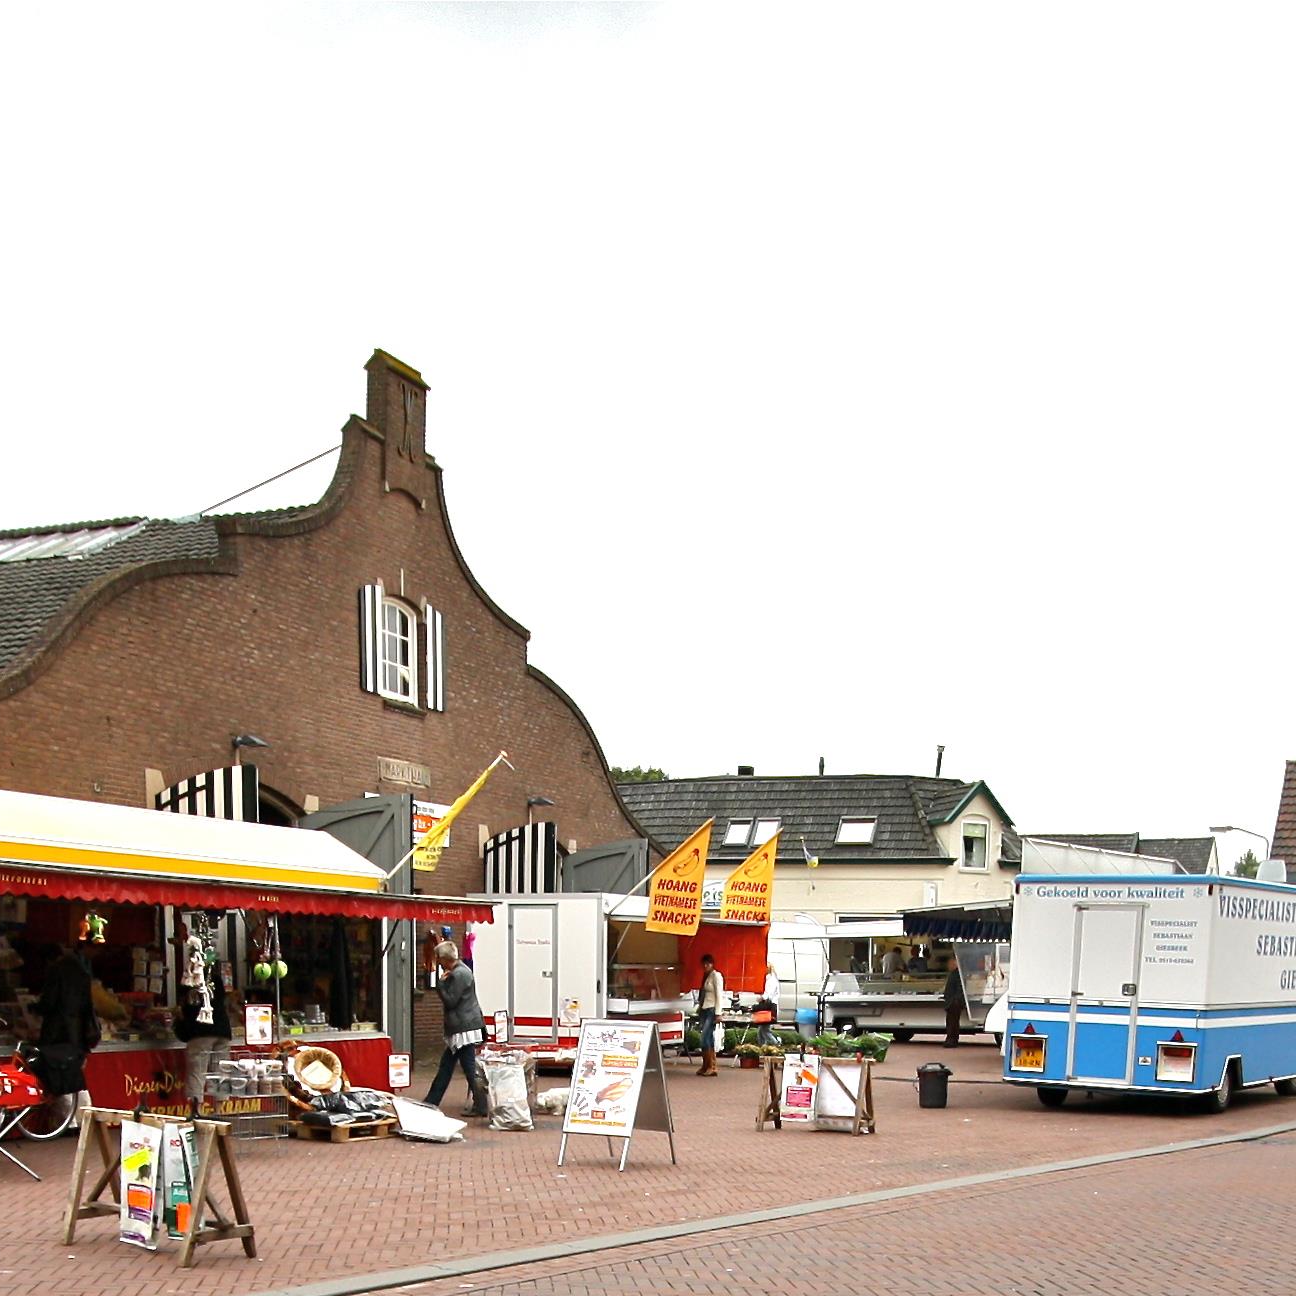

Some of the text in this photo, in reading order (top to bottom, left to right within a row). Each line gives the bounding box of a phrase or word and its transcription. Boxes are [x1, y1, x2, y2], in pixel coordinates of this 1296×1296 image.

[657, 879, 697, 893] HOANG
[730, 881, 767, 893] HOANG
[1037, 886, 1184, 899] Gekoeld voor kwaliteit
[654, 894, 697, 909] VIETNAMESE
[726, 895, 766, 907] VIETNAMESE
[1219, 895, 1296, 922] VISSPECIALIST
[652, 911, 696, 926] SNACKS
[724, 909, 766, 922] SNACKS
